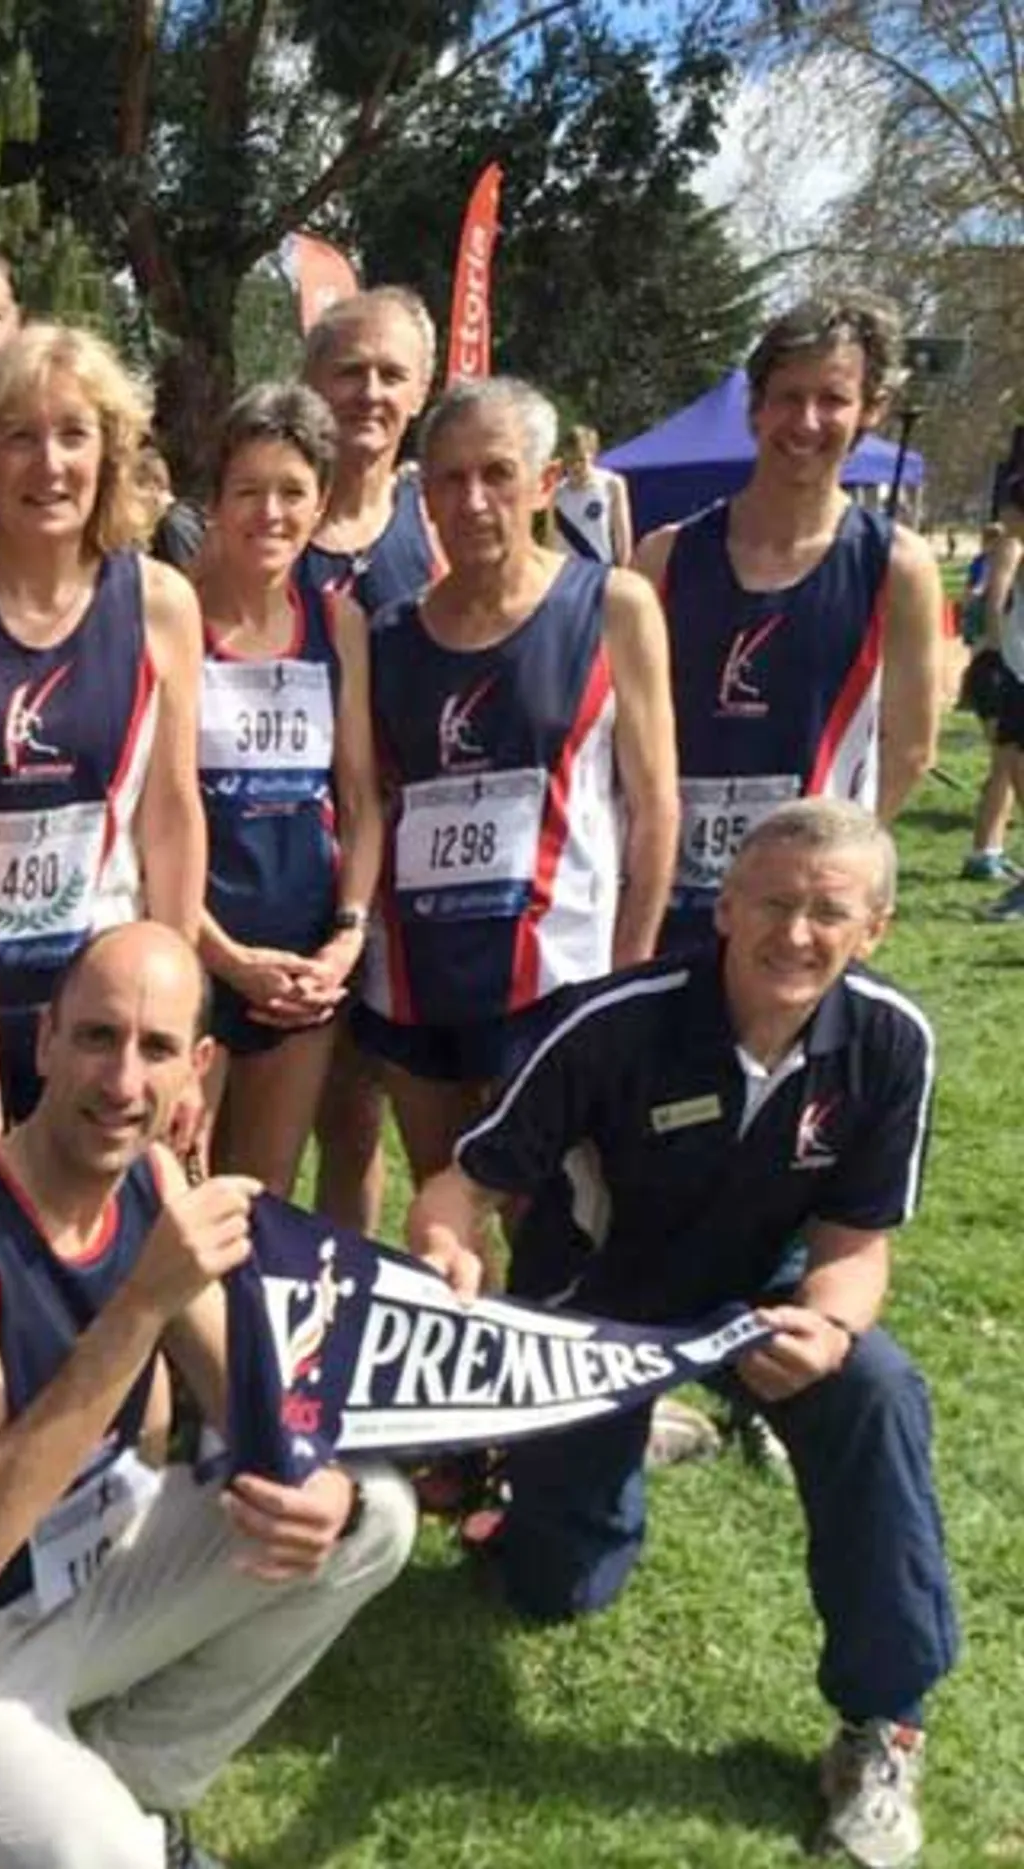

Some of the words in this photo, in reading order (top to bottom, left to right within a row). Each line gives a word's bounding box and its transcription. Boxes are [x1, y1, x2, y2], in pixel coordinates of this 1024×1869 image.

[235, 708, 308, 752] 3010
[429, 820, 498, 870] 1298
[1, 852, 59, 901] 480
[346, 1299, 676, 1407] PREMIERS
